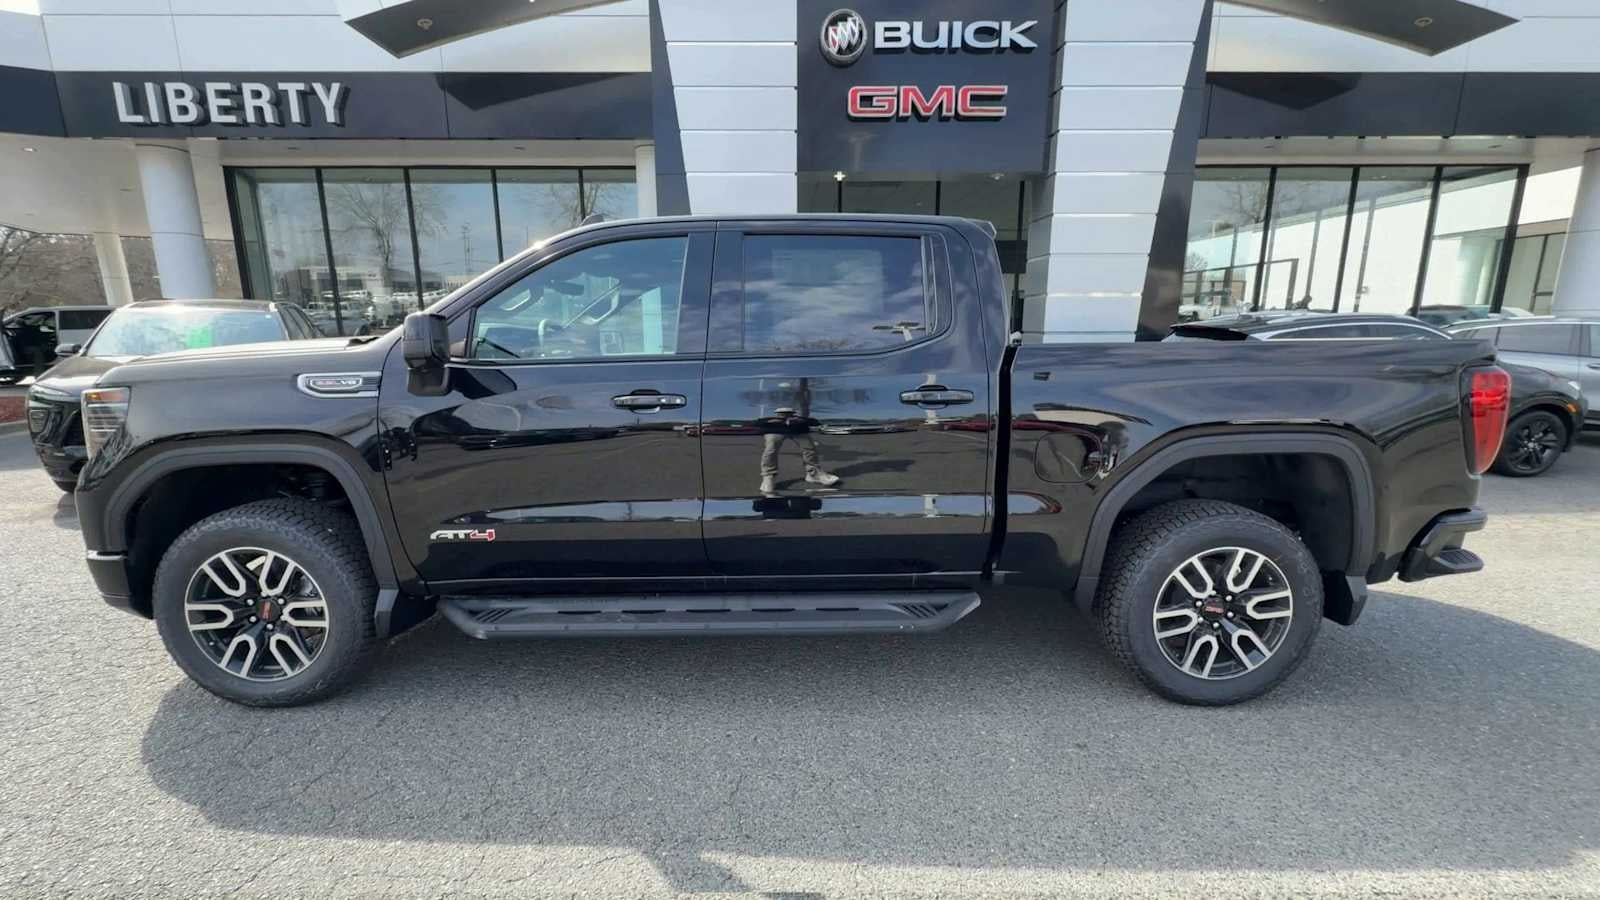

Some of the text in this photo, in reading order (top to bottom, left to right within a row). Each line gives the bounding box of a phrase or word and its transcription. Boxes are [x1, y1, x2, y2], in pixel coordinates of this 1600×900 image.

[874, 20, 1038, 49] BUICK
[112, 82, 343, 125] LIBERTY
[847, 84, 1009, 117] GMC
[430, 529, 496, 541] AT4
